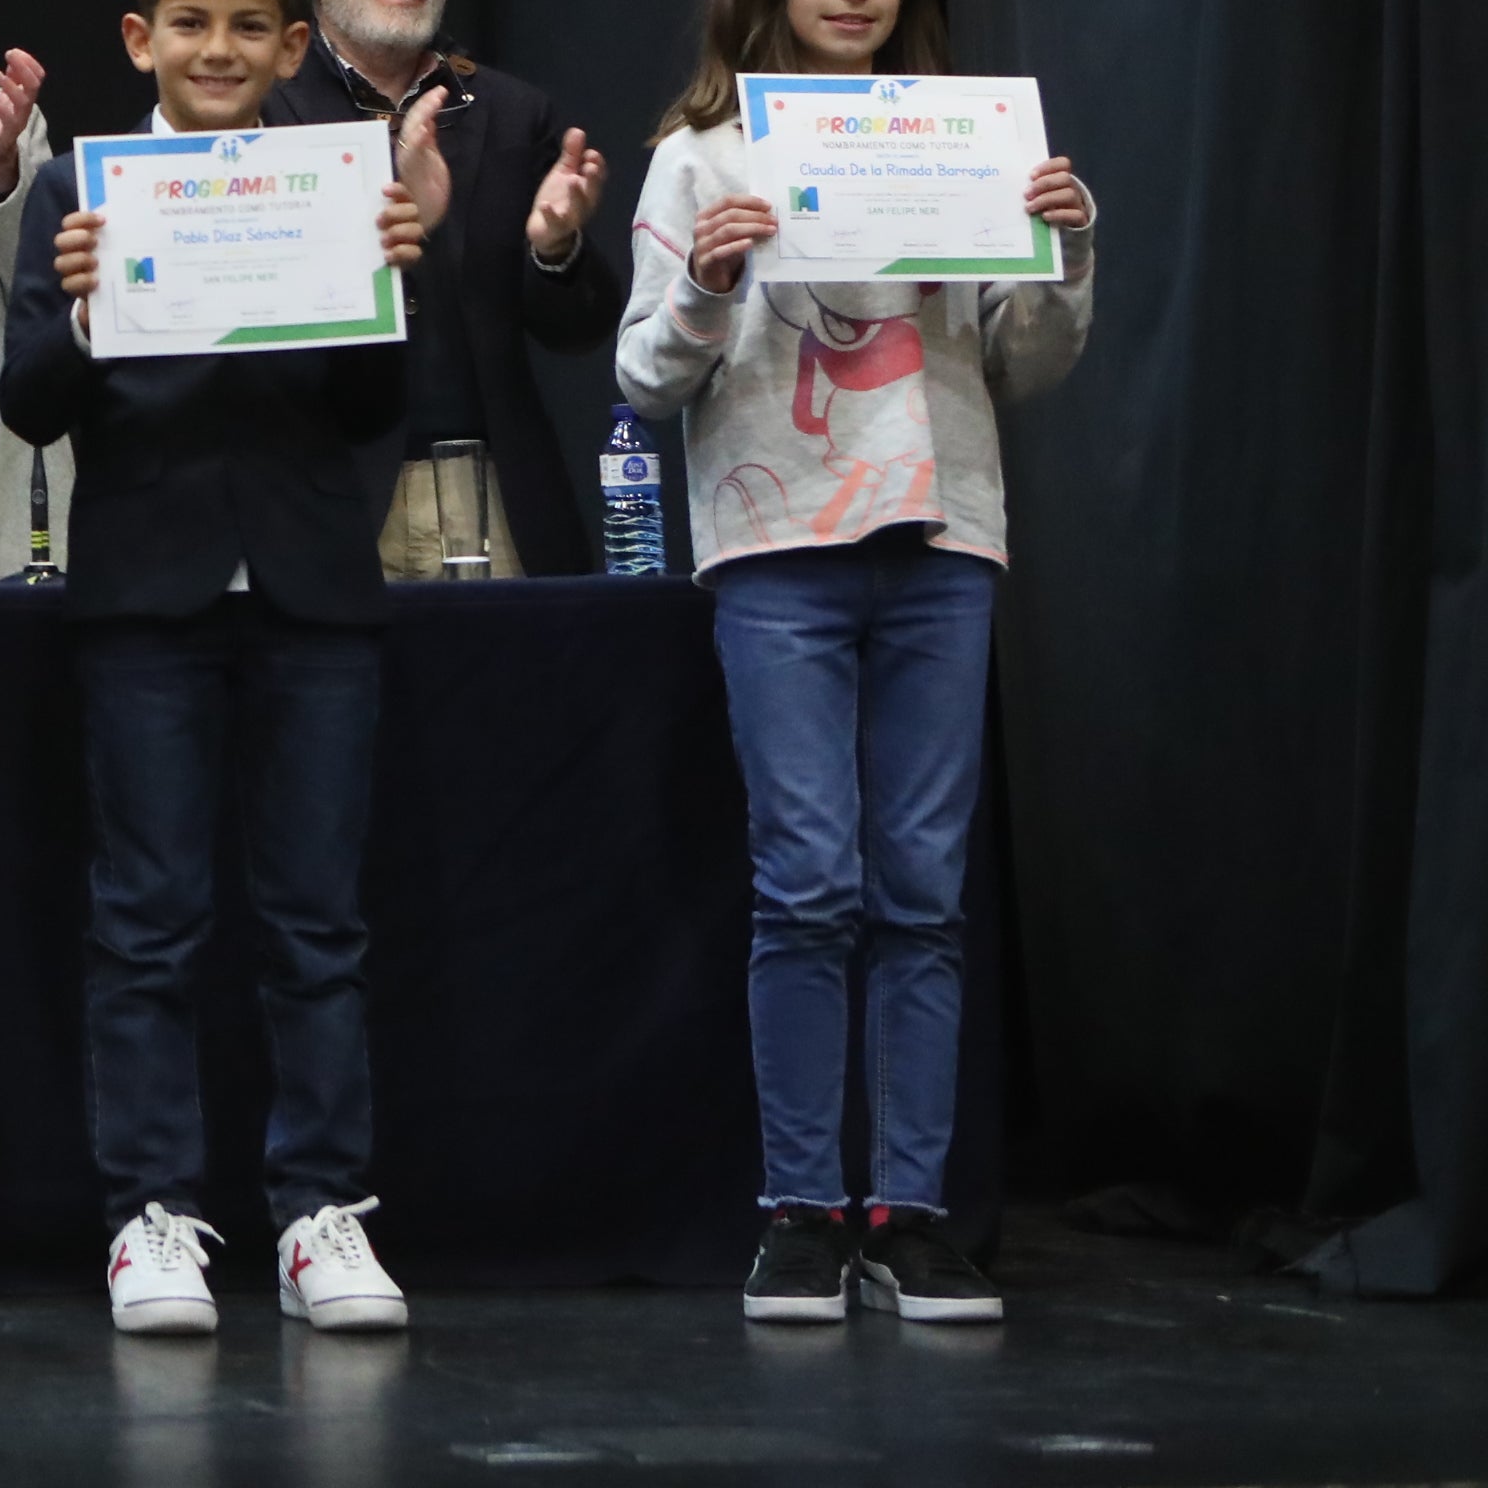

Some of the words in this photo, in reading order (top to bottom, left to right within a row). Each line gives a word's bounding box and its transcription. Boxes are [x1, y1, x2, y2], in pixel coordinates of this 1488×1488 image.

[816, 116, 936, 135] PROGRAMA
[821, 141, 897, 150] NOMBRAMIENTO
[899, 142, 926, 150] COMO
[799, 162, 846, 177] Claudia
[850, 163, 866, 176] De
[870, 163, 883, 176] la
[886, 163, 933, 177] Rimada
[936, 163, 1000, 179] Barragán
[154, 176, 276, 199] PROGRAMA
[173, 231, 208, 244] Pablo
